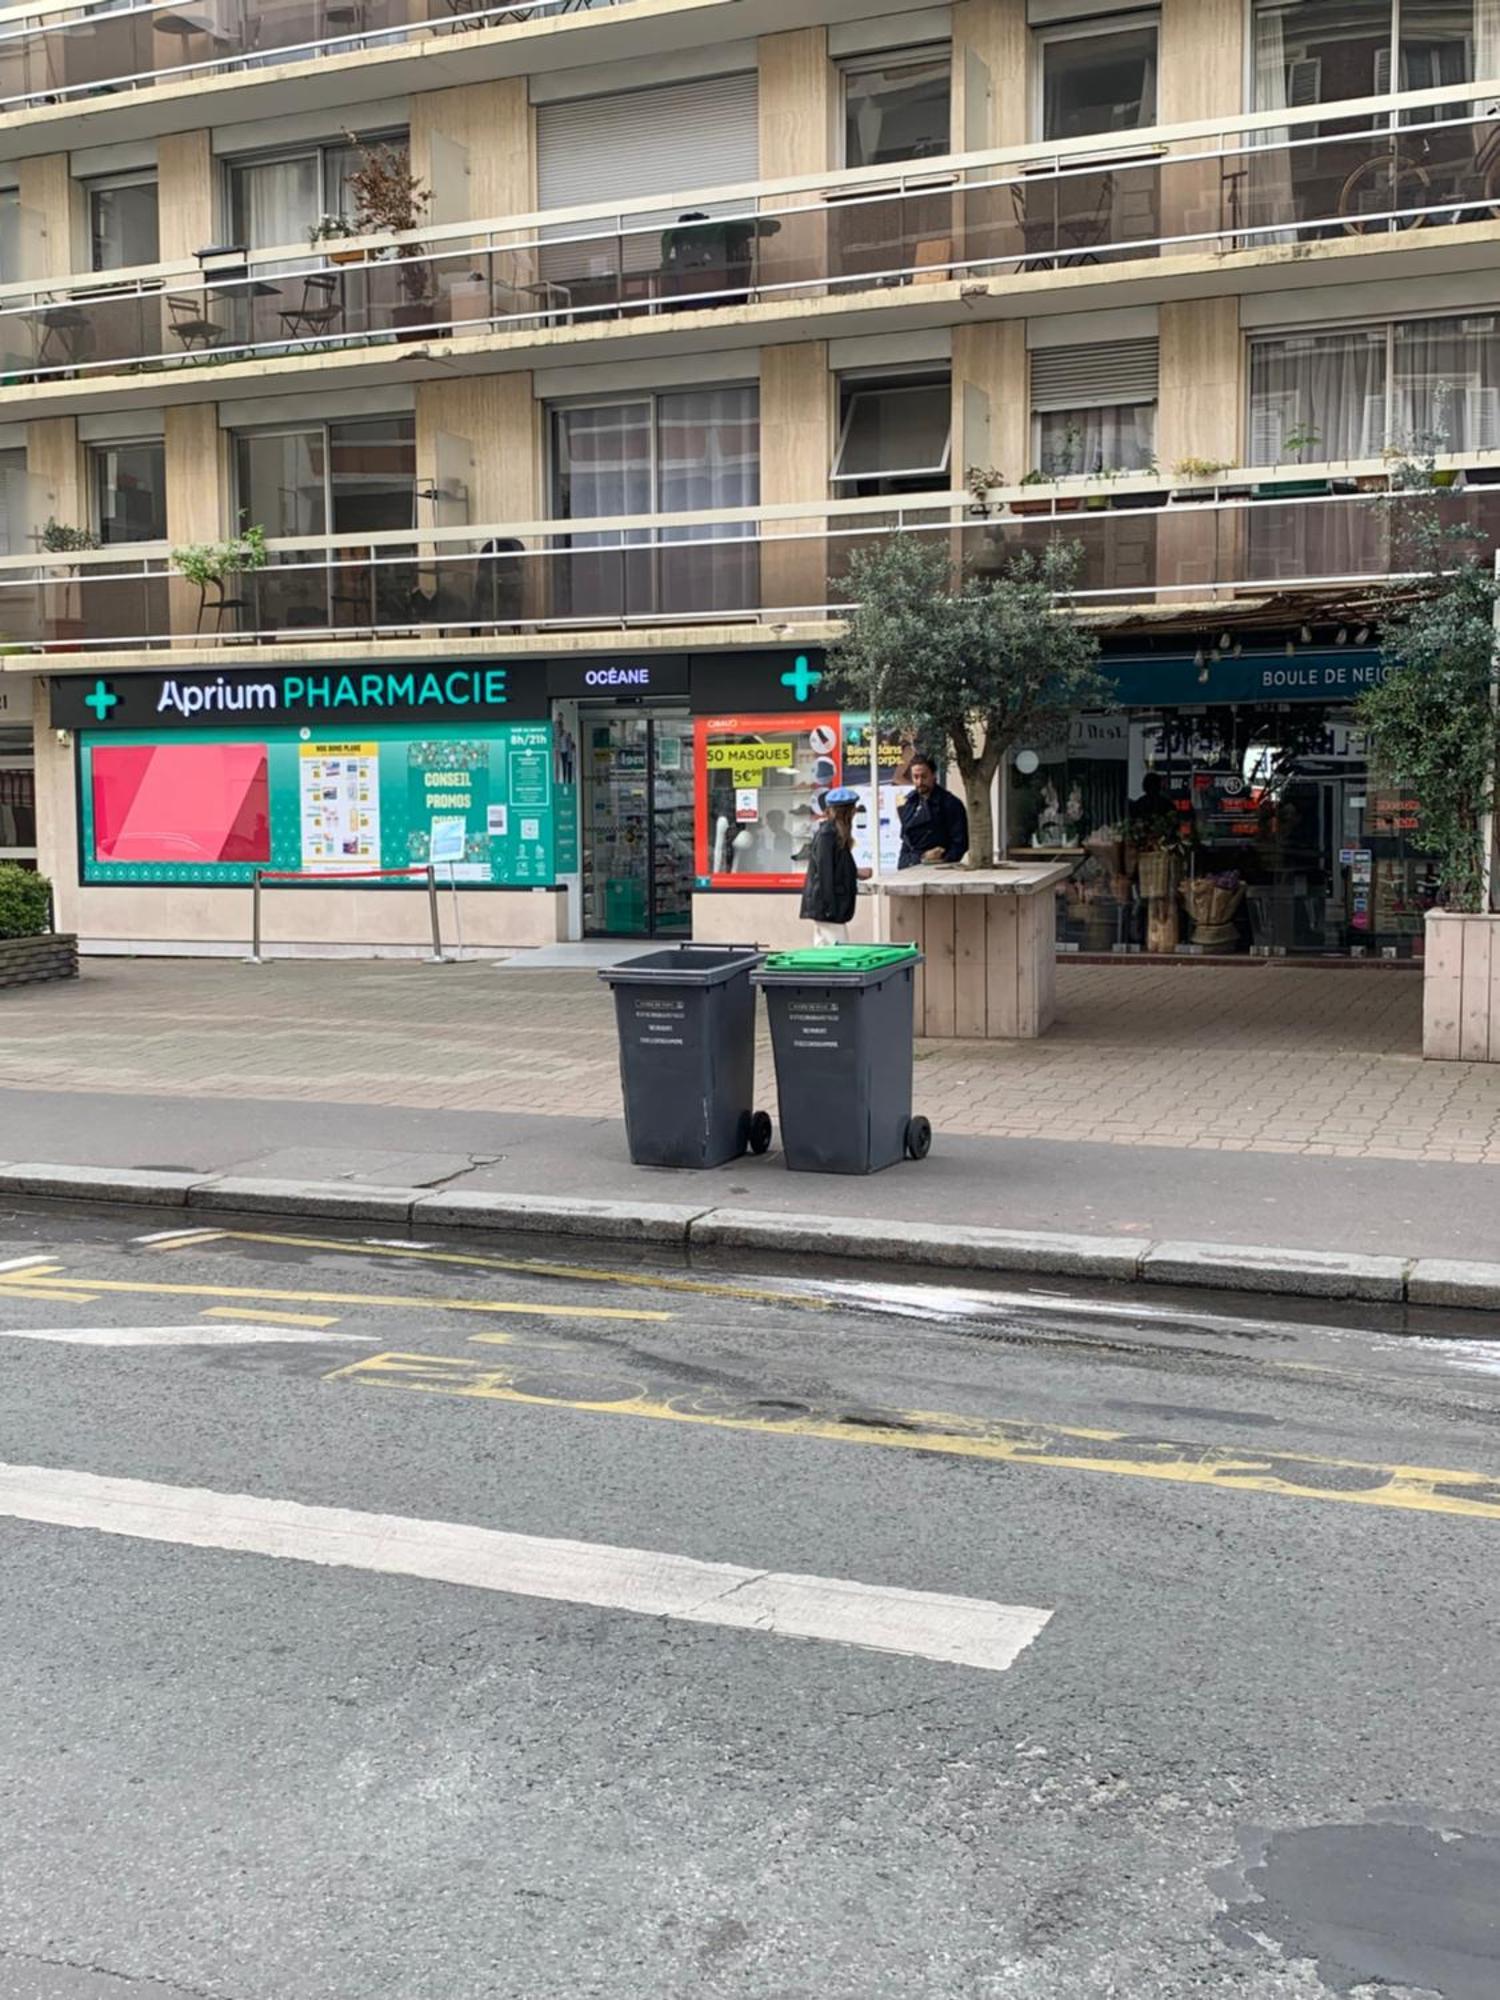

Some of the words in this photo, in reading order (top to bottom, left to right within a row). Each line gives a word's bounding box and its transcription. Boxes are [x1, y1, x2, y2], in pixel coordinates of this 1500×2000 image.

[585, 666, 649, 685] OCÉANE
[1262, 669, 1318, 686] BOULE
[1324, 668, 1347, 684] DE
[157, 677, 276, 717] Aprium
[283, 671, 507, 708] PHARMACIE
[707, 749, 724, 762] 50
[728, 749, 790, 761] MASQUES
[424, 772, 472, 787] CONSEIL
[426, 794, 472, 809] PROMOS
